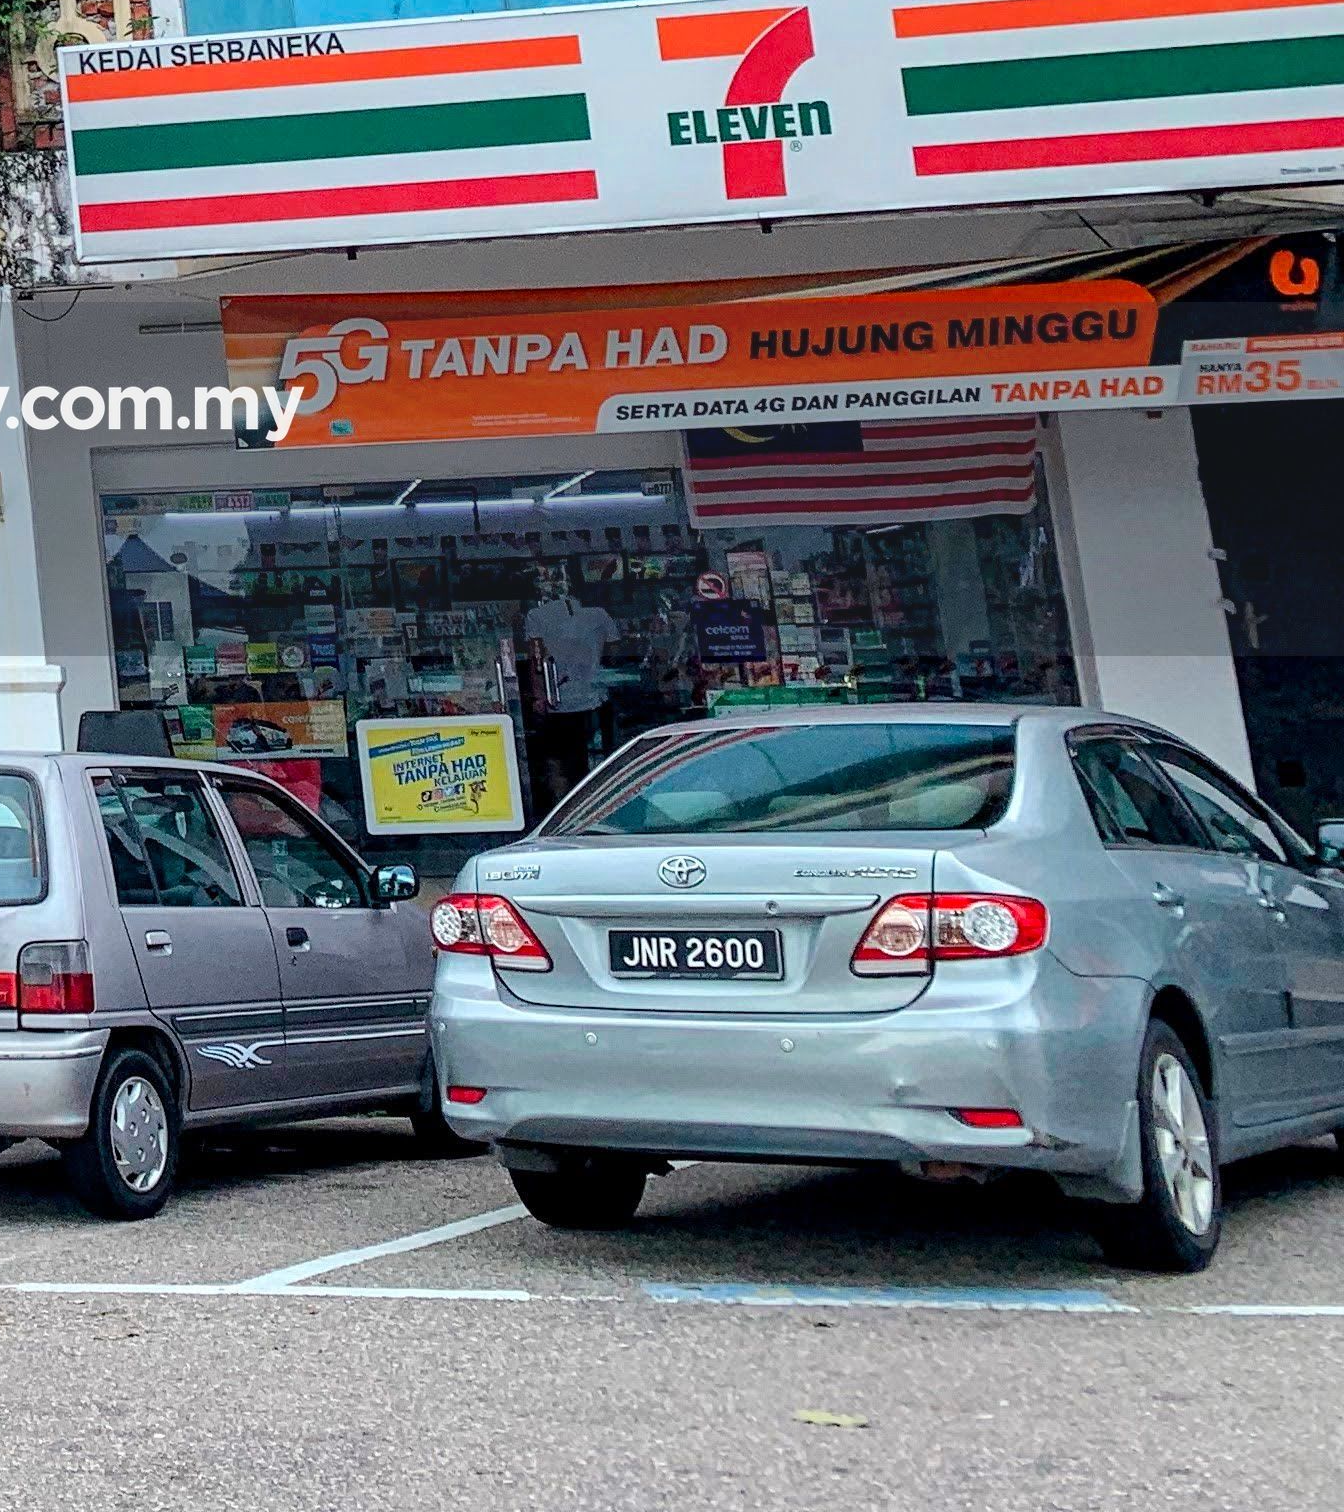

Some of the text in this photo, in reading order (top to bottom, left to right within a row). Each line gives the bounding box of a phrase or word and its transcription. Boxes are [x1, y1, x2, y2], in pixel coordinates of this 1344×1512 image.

[79, 32, 344, 75] KEDAI SERBANEKA
[656, 5, 815, 200] 7
[400, 332, 588, 379] TANPA
[605, 324, 729, 371] HAD
[750, 321, 932, 361] HUJUNG
[947, 308, 1138, 350] MINGGU
[616, 376, 1164, 421] SERTA DATA 4G DAN PANGGILAN TANPA HAD
[394, 754, 487, 786] TANPA HAD
[623, 936, 765, 969] JNR 2600
